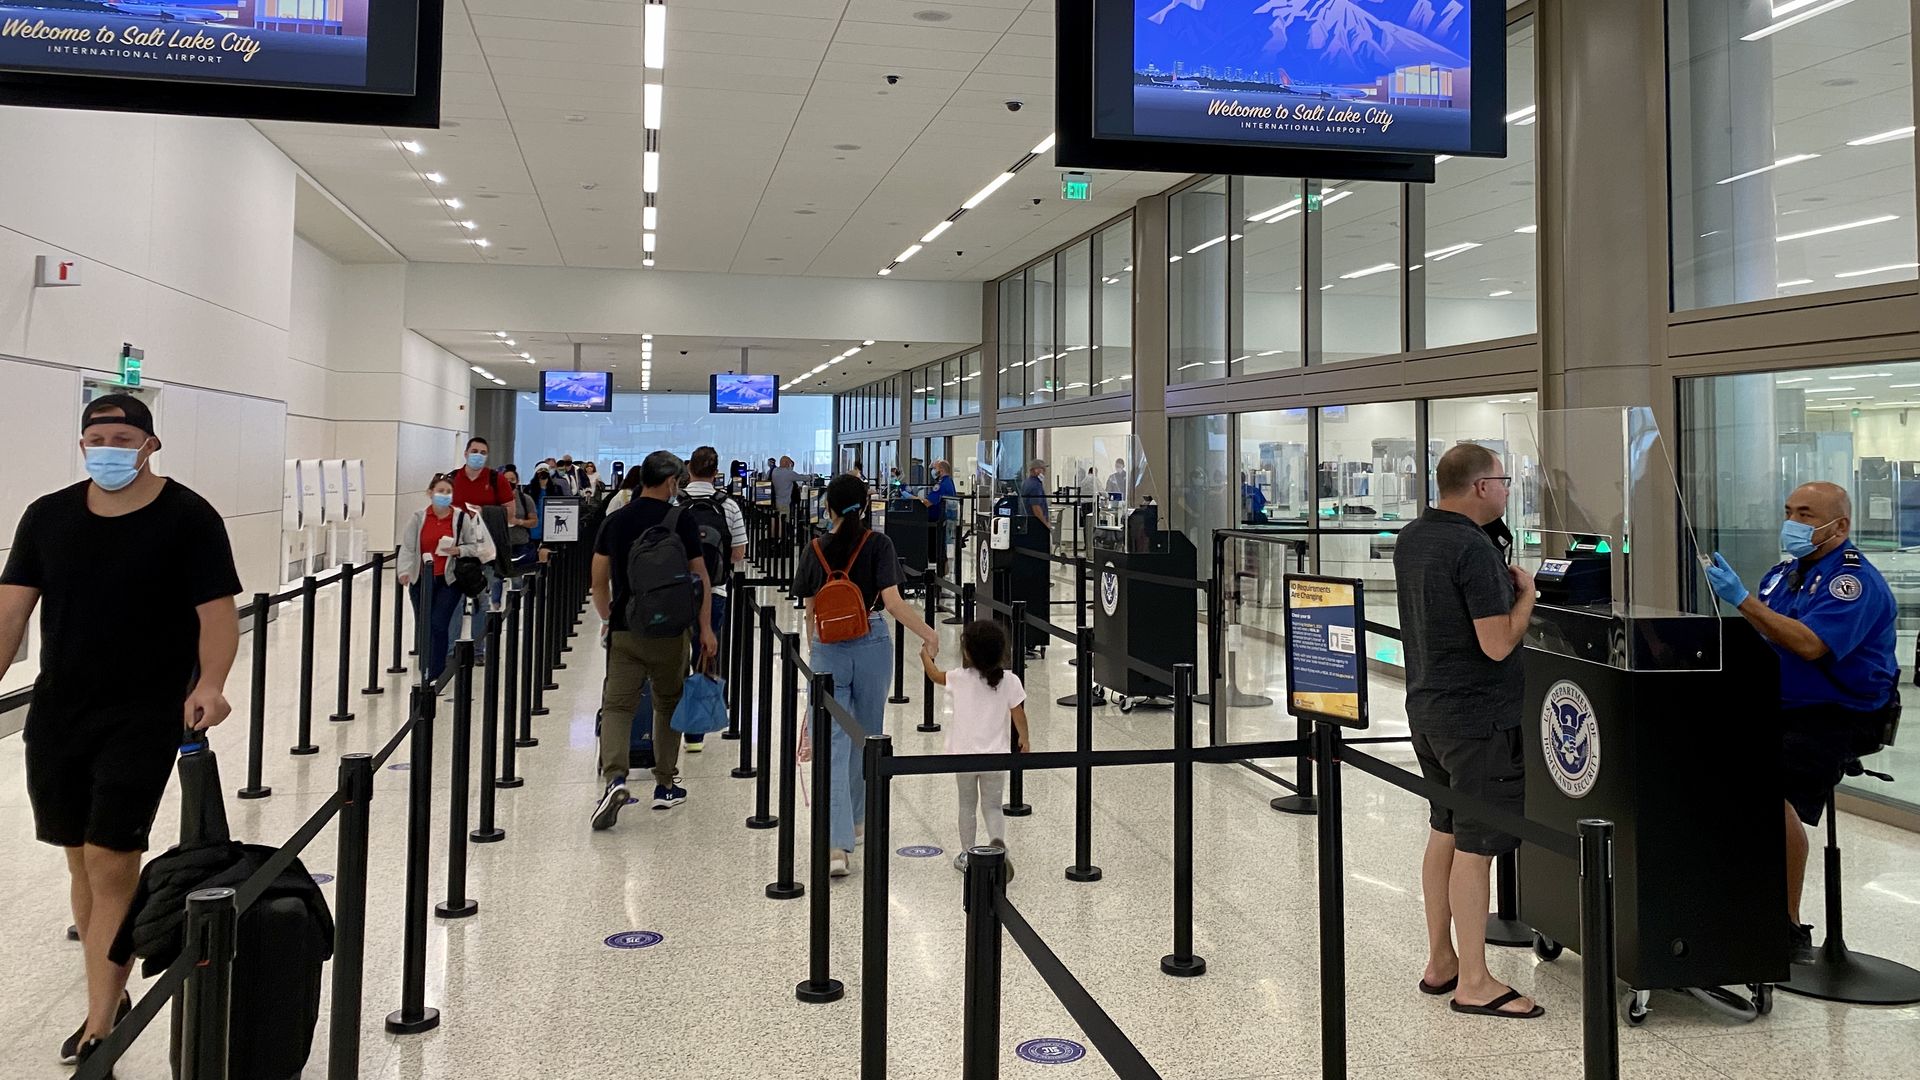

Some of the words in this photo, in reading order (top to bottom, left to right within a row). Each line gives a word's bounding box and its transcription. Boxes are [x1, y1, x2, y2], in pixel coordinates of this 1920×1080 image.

[2, 18, 91, 42] Welcome
[96, 25, 116, 44] to
[119, 26, 165, 48] Salt
[168, 29, 216, 50] Lake
[220, 32, 261, 63] City
[48, 45, 158, 60] INTERNATIONAL
[165, 53, 223, 63] AIRPORT
[1208, 99, 1272, 118] Welcome
[1275, 104, 1289, 119] to
[1292, 103, 1325, 122] Salt
[1327, 105, 1361, 123] Lake
[1365, 107, 1394, 132] City
[1241, 121, 1321, 132] INTERNATIONAL
[1325, 126, 1367, 134] AIRPORT
[1067, 182, 1088, 199] EXIT
[1297, 584, 1331, 593] Requirements
[1301, 593, 1323, 602] Changing
[1551, 686, 1592, 719] DEPARTMENT
[1589, 722, 1597, 738] OF
[1544, 737, 1572, 791] HOMELAND
[1573, 754, 1597, 792] SECURITY
